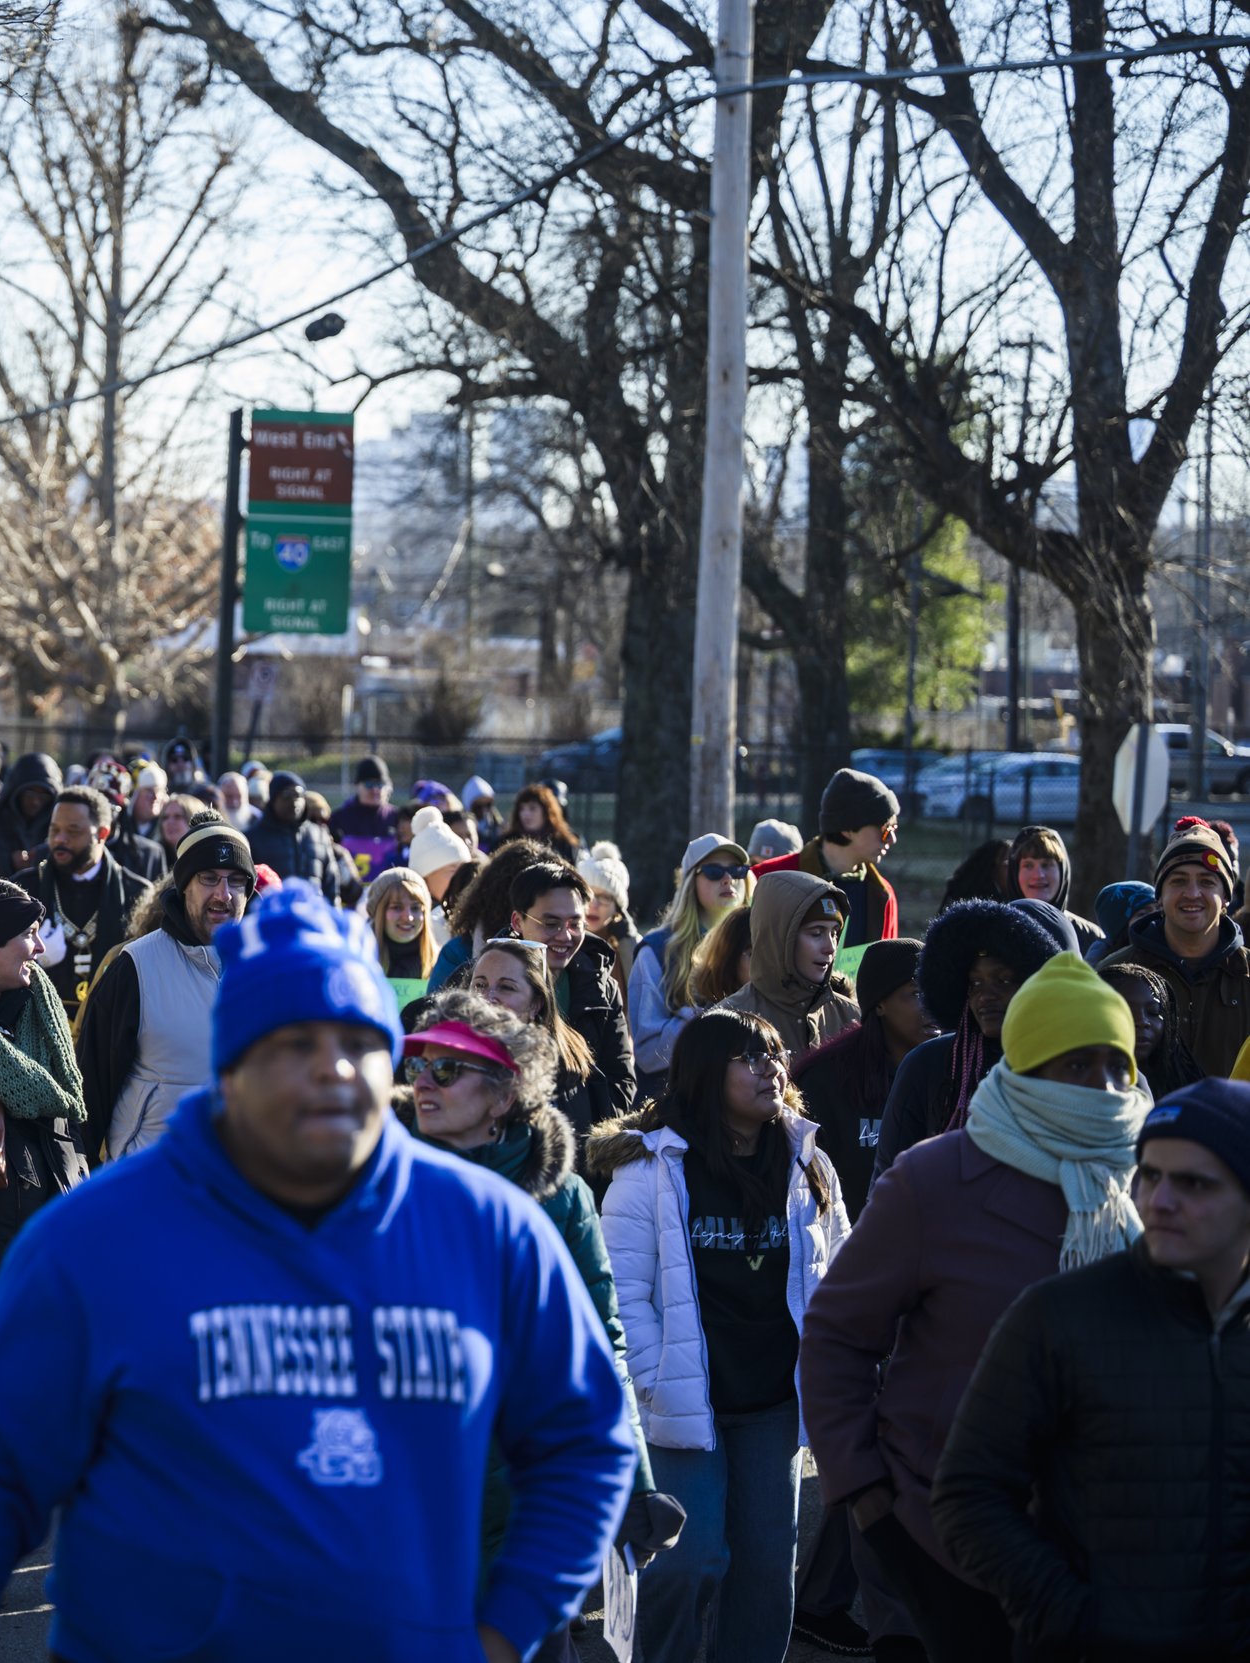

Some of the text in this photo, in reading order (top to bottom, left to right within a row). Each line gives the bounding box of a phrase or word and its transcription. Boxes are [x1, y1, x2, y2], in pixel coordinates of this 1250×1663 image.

[253, 429, 336, 449] West End
[269, 466, 332, 482] RIGHT AT
[691, 1223, 747, 1246] Legacy
[190, 1305, 466, 1403] TENNESSEE STATE
